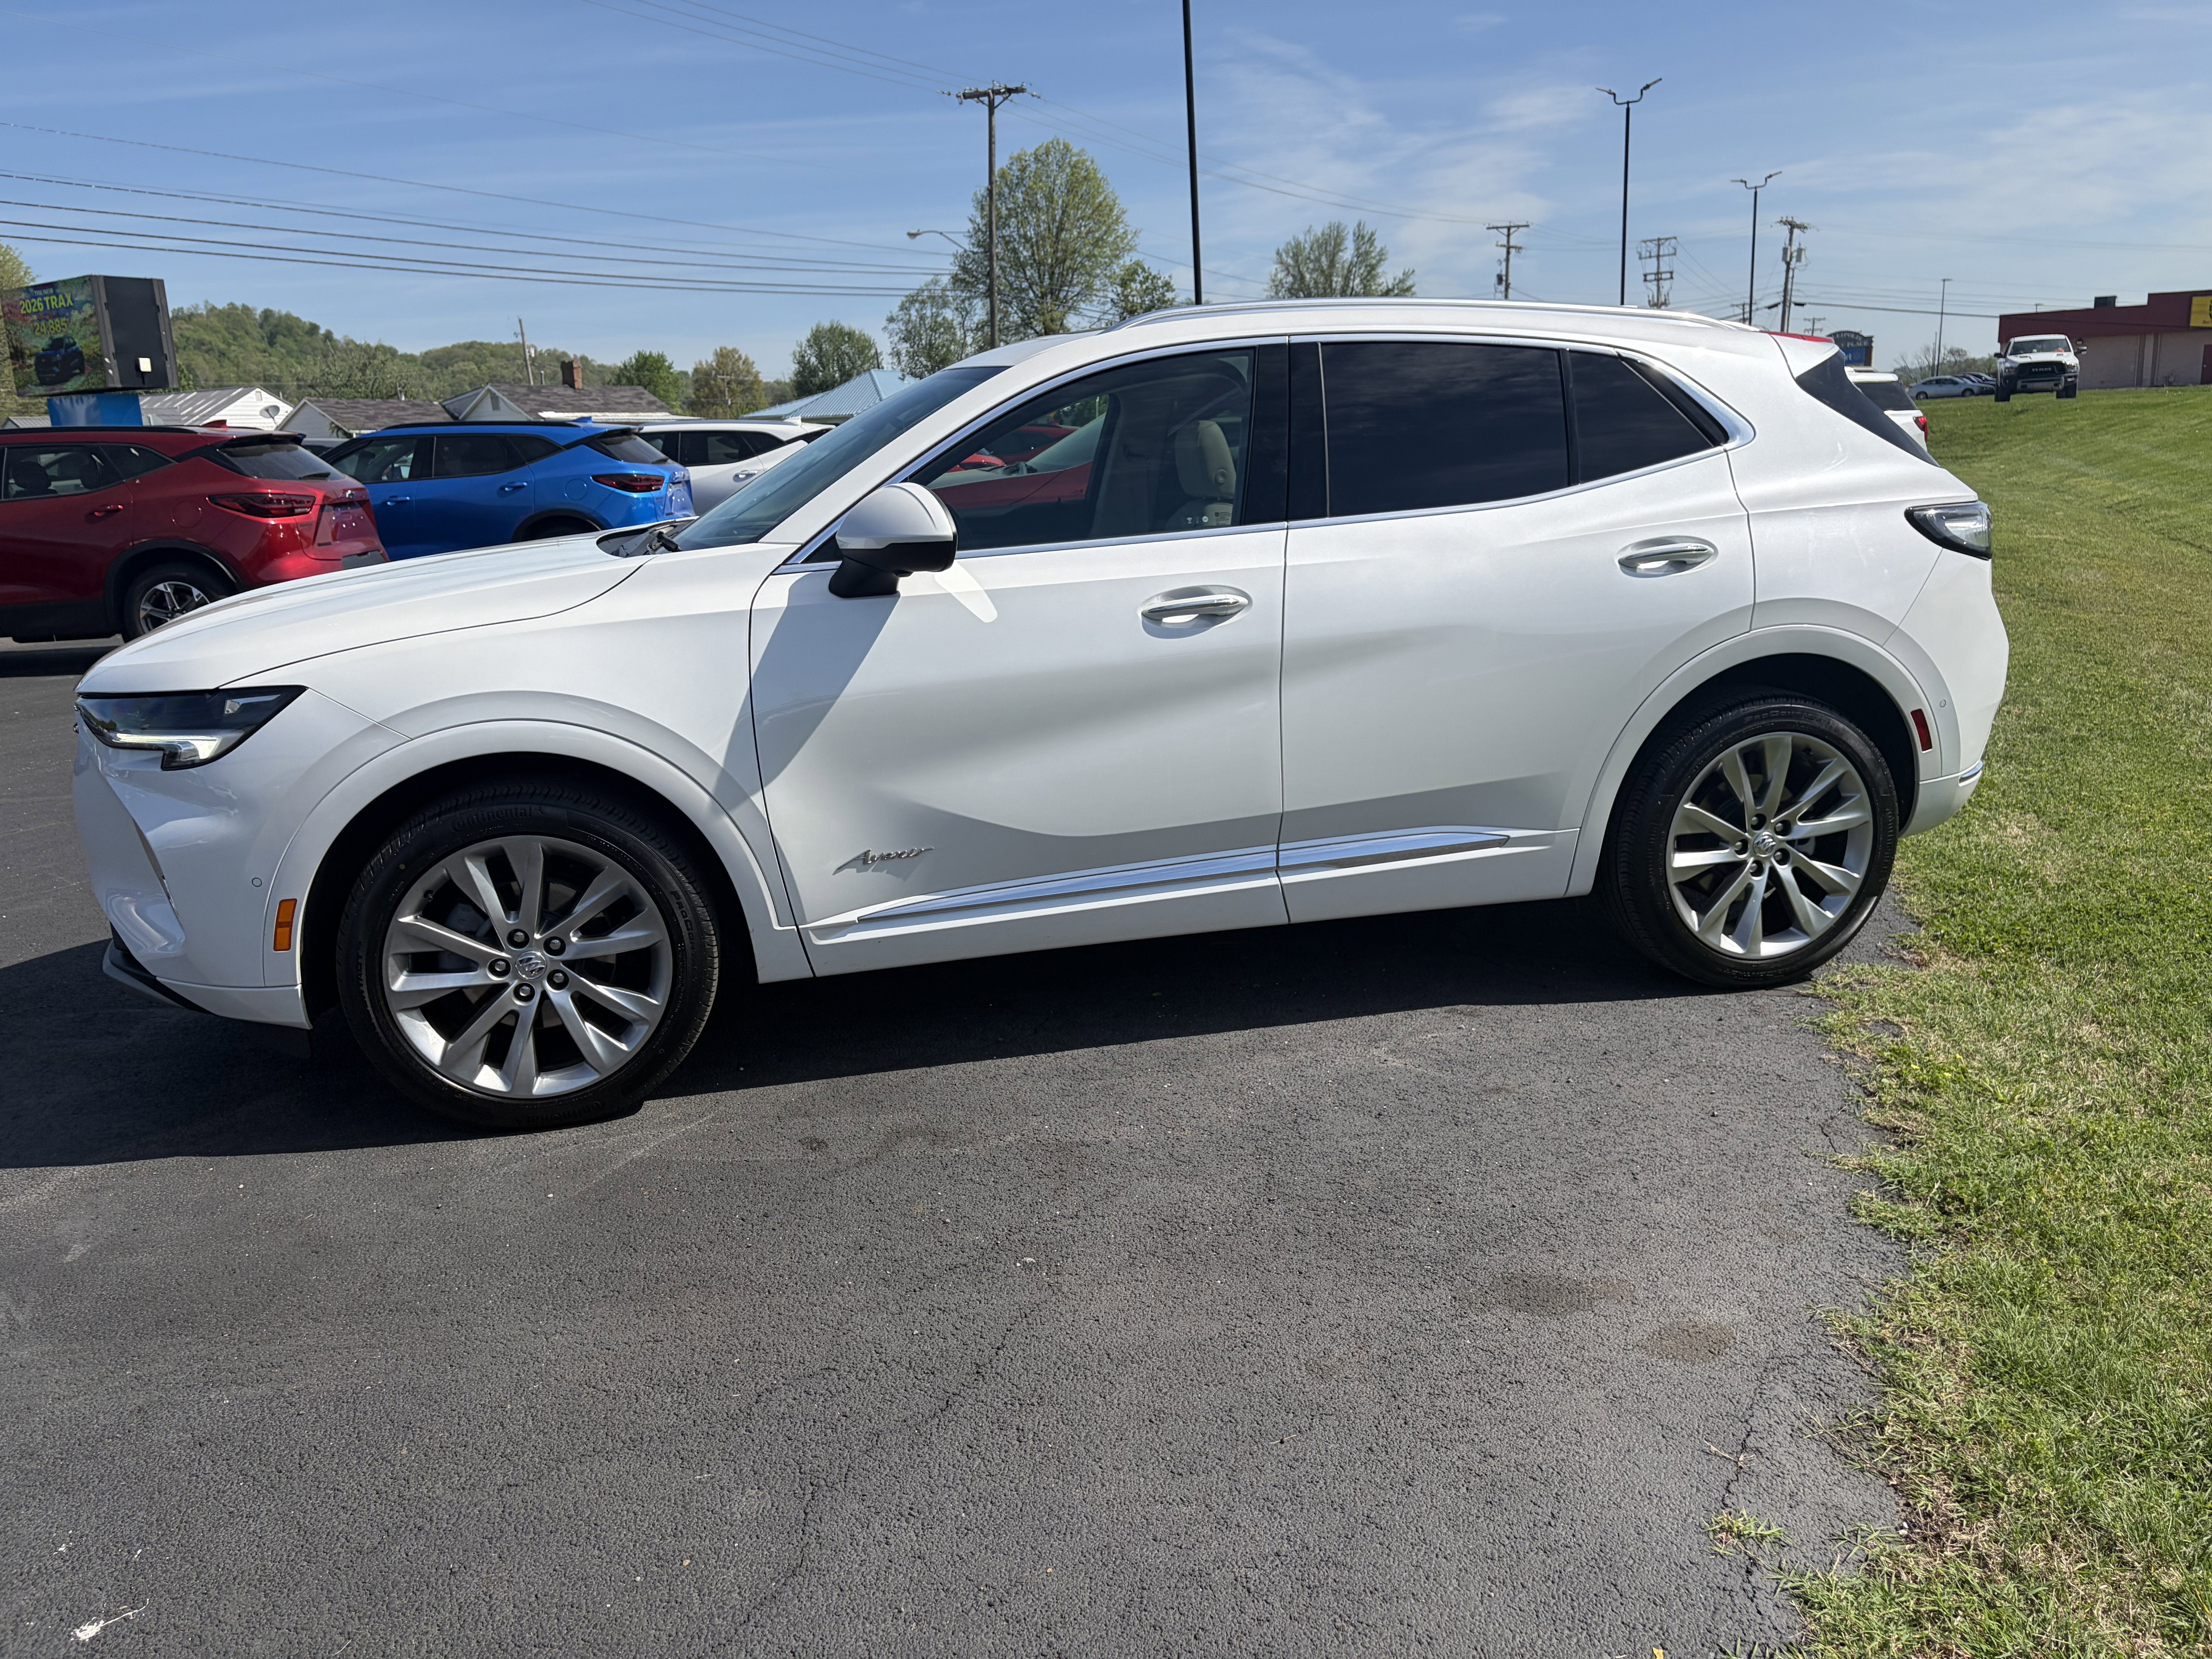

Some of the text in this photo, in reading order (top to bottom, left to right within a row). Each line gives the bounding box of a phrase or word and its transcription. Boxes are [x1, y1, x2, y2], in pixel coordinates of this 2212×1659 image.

[19, 293, 74, 314] 2026 TRAX
[451, 805, 532, 833] Continental
